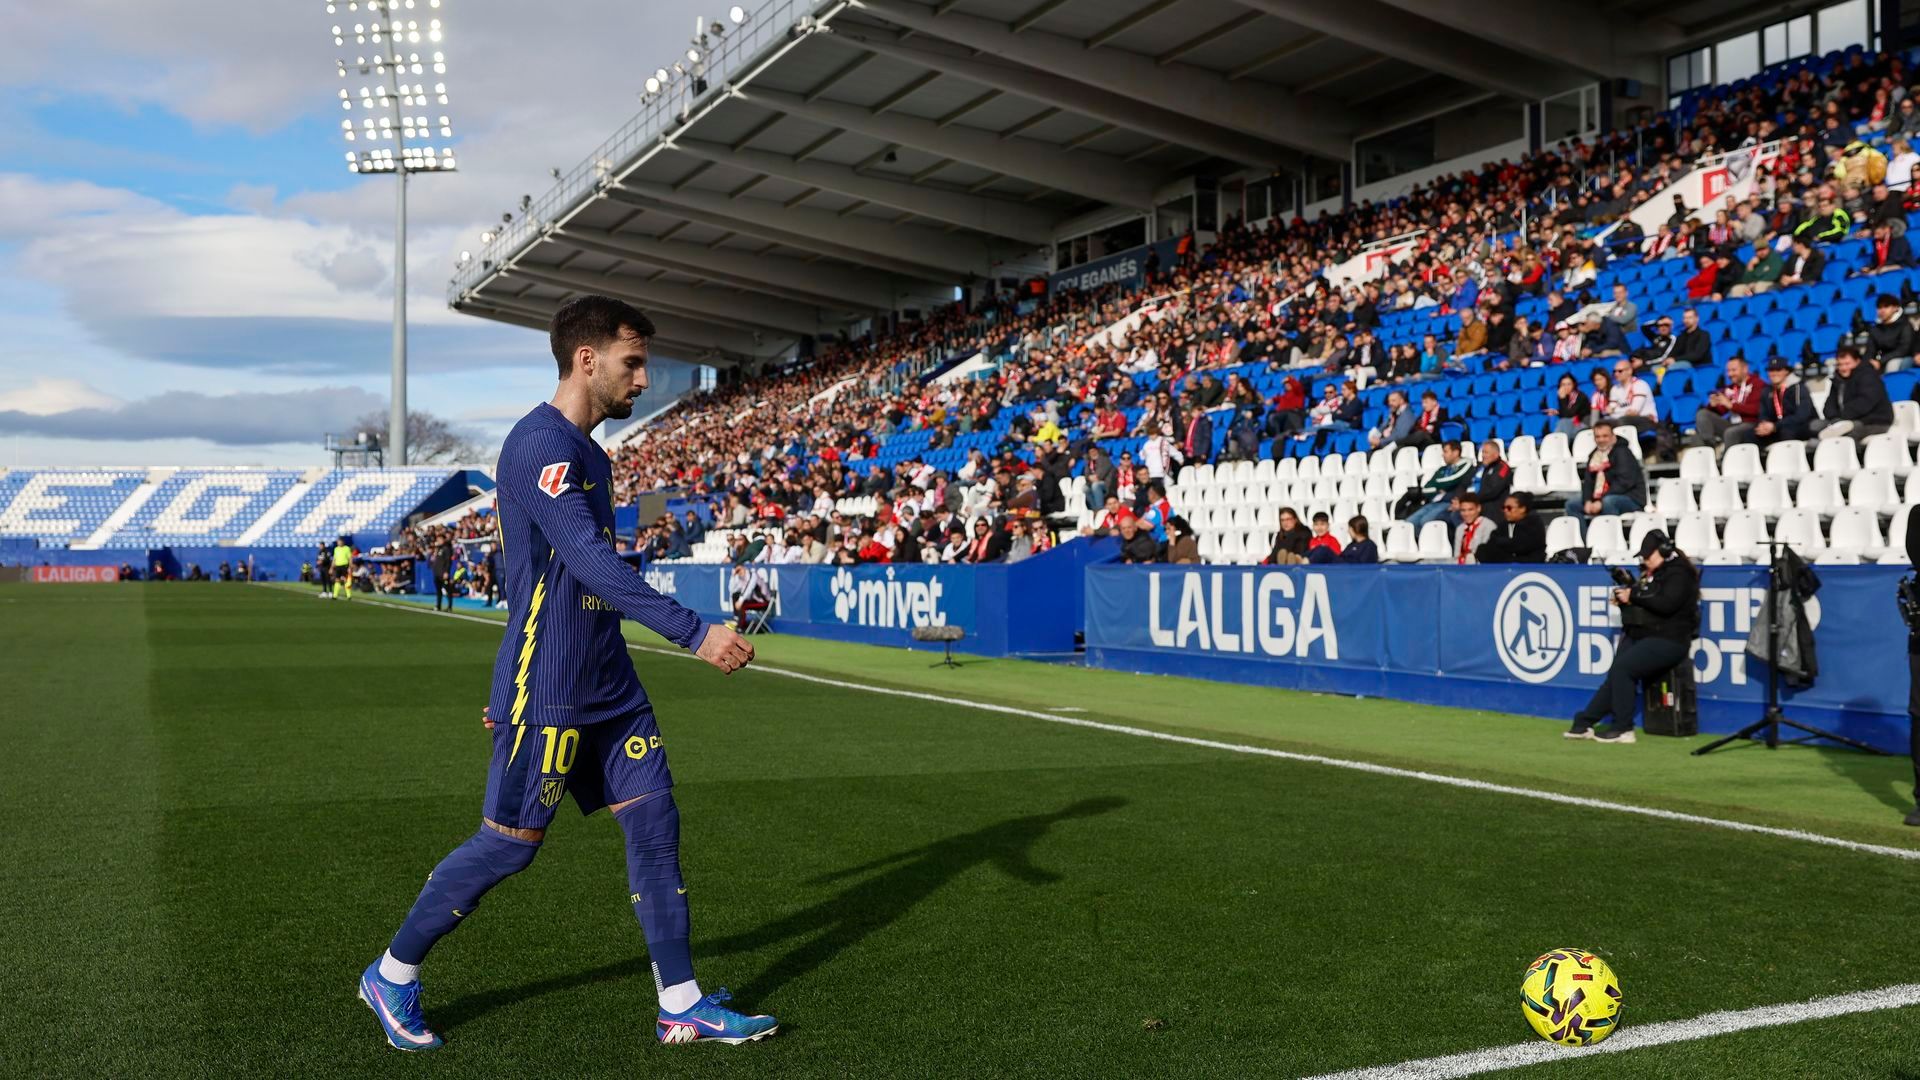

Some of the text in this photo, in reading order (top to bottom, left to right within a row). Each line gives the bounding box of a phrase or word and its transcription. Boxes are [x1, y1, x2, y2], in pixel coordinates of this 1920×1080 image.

[38, 567, 97, 583] LALIGA
[858, 566, 947, 628] mivet
[1149, 571, 1338, 660] LALIGA
[1578, 632, 1747, 686] DOT
[541, 726, 580, 775] 10
